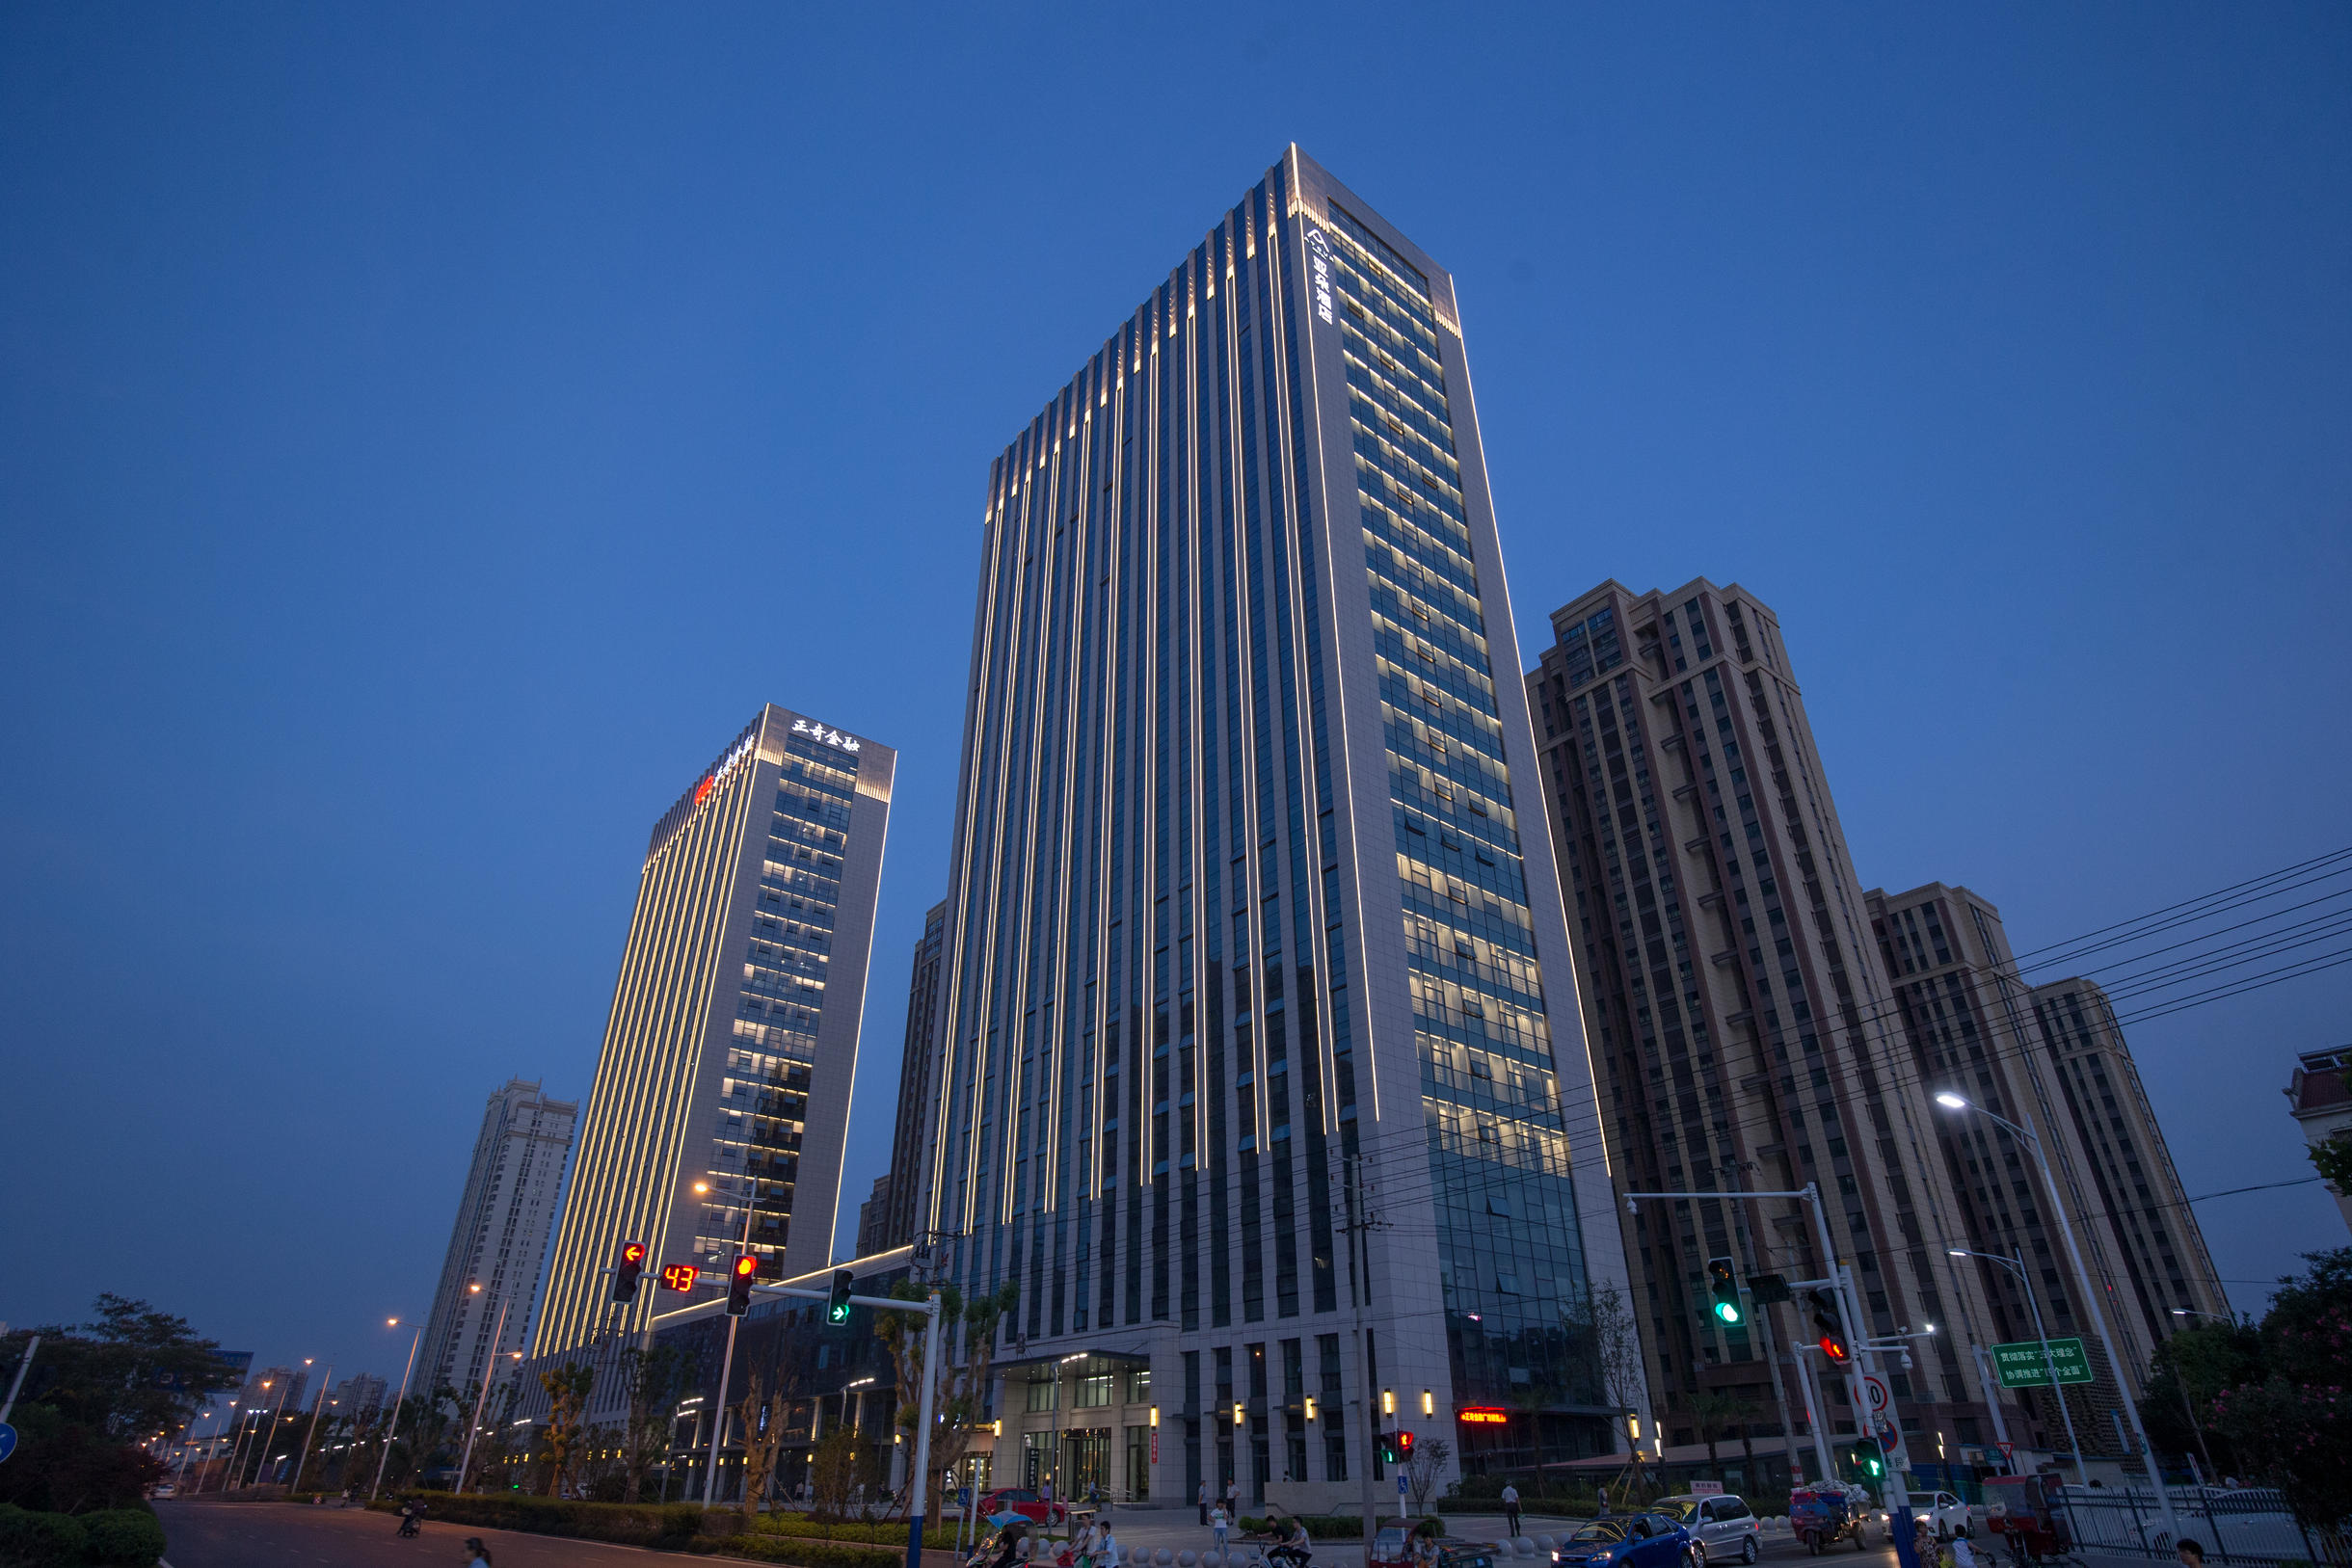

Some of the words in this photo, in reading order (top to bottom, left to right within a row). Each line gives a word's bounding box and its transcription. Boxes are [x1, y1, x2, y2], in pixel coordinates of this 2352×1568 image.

[1313, 255, 1333, 326] 亚朵酒店
[791, 719, 861, 752] 正奇金融
[664, 1266, 695, 1292] 43
